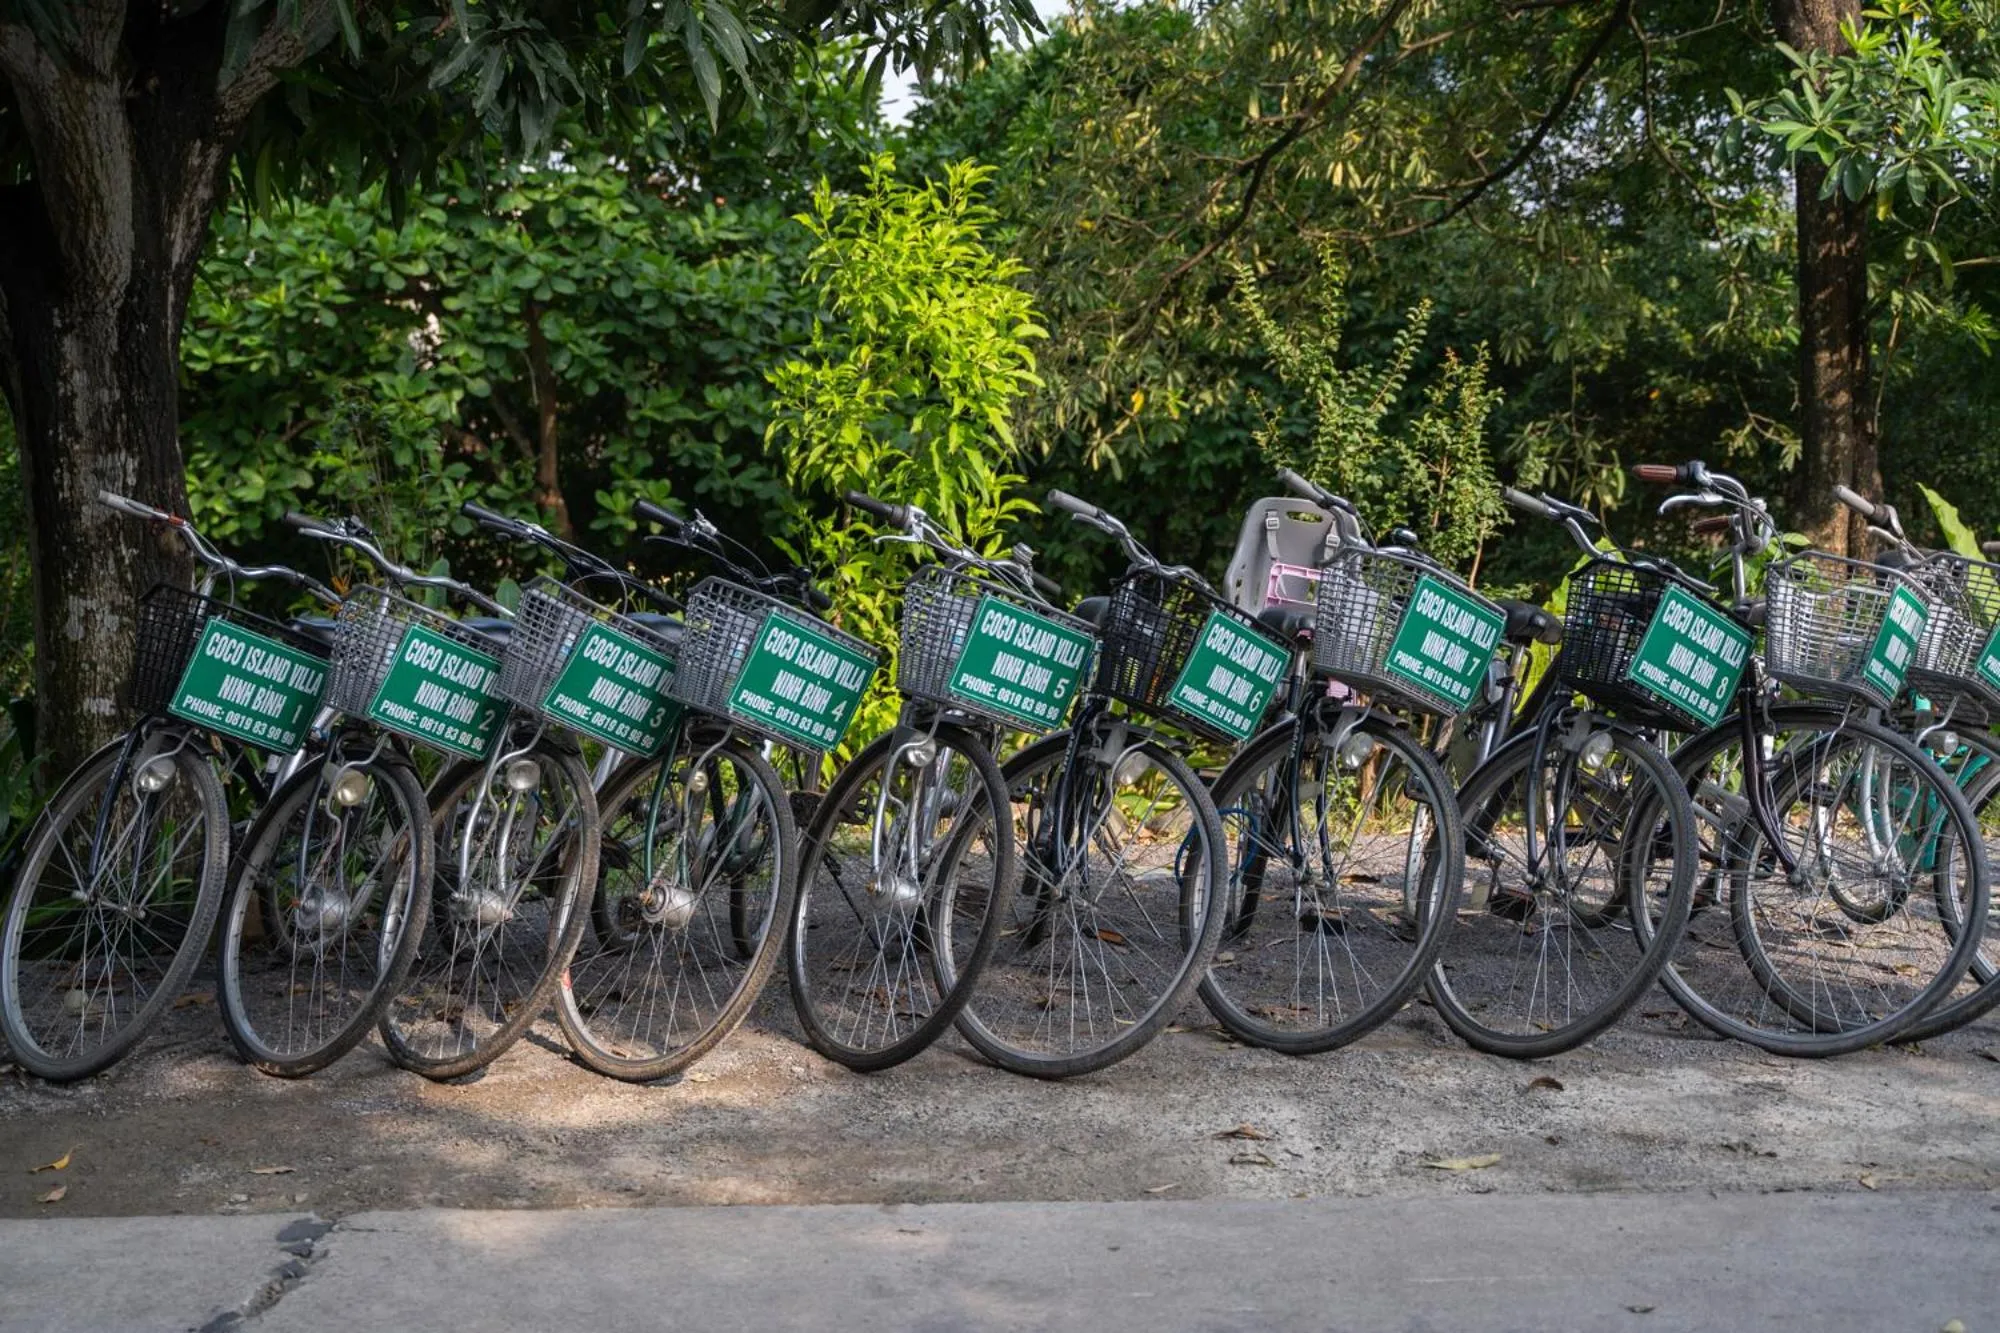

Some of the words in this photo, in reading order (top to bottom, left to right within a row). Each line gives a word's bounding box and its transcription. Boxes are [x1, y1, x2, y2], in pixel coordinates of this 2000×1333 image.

[1416, 588, 1445, 622] COCO
[1440, 602, 1476, 638] ISLAND
[1470, 618, 1496, 651] VILLA
[1663, 600, 1694, 634] COCO
[1688, 615, 1725, 654] ISLAND
[1719, 634, 1747, 669] VILLA
[981, 609, 1016, 643] COCO
[1013, 622, 1056, 659] ISLAND
[1054, 638, 1086, 670] VILLA
[1206, 623, 1235, 656] COCO
[1228, 638, 1263, 672] ISLAND
[1257, 652, 1282, 684] VILLA
[206, 632, 246, 666] COCO
[242, 646, 291, 683] ISLAND
[288, 663, 323, 696] VILLA
[405, 638, 443, 672] COCO
[438, 653, 485, 690] ISLAND
[583, 634, 621, 668] COCO
[615, 650, 661, 688] ISLAND
[764, 627, 800, 661] COCO
[795, 641, 839, 679] ISLAND
[834, 659, 867, 693] VILLA
[991, 651, 1026, 684] NINH
[1467, 657, 1480, 676] 7
[217, 674, 255, 707] NINH
[414, 680, 450, 712] NINH
[588, 676, 625, 709] NINH
[771, 669, 806, 704] NINH
[959, 673, 997, 698] PHONE:
[997, 687, 1022, 707] 0819
[1021, 697, 1034, 711] 83
[1034, 702, 1047, 716] 98
[1053, 678, 1070, 699] 5
[1249, 691, 1263, 712] 6
[1716, 676, 1729, 699] 8
[183, 695, 225, 720] PHONE:
[225, 711, 251, 730] 0819
[252, 721, 267, 735] 83
[269, 727, 281, 740] 98
[292, 705, 302, 724] 1
[379, 700, 419, 725] PHONE:
[419, 716, 444, 735] 0819
[444, 726, 458, 740] 83
[458, 733, 472, 745] 98
[478, 710, 496, 731] 2
[554, 694, 592, 720] PHONE:
[592, 712, 617, 731] 0819
[615, 723, 630, 738] 83
[629, 729, 643, 742] 98
[650, 708, 666, 728] 3
[739, 689, 776, 715] PHONE:
[775, 706, 799, 725] 0819
[798, 717, 812, 732] 83
[812, 723, 825, 737] 98
[832, 700, 847, 722] 4
